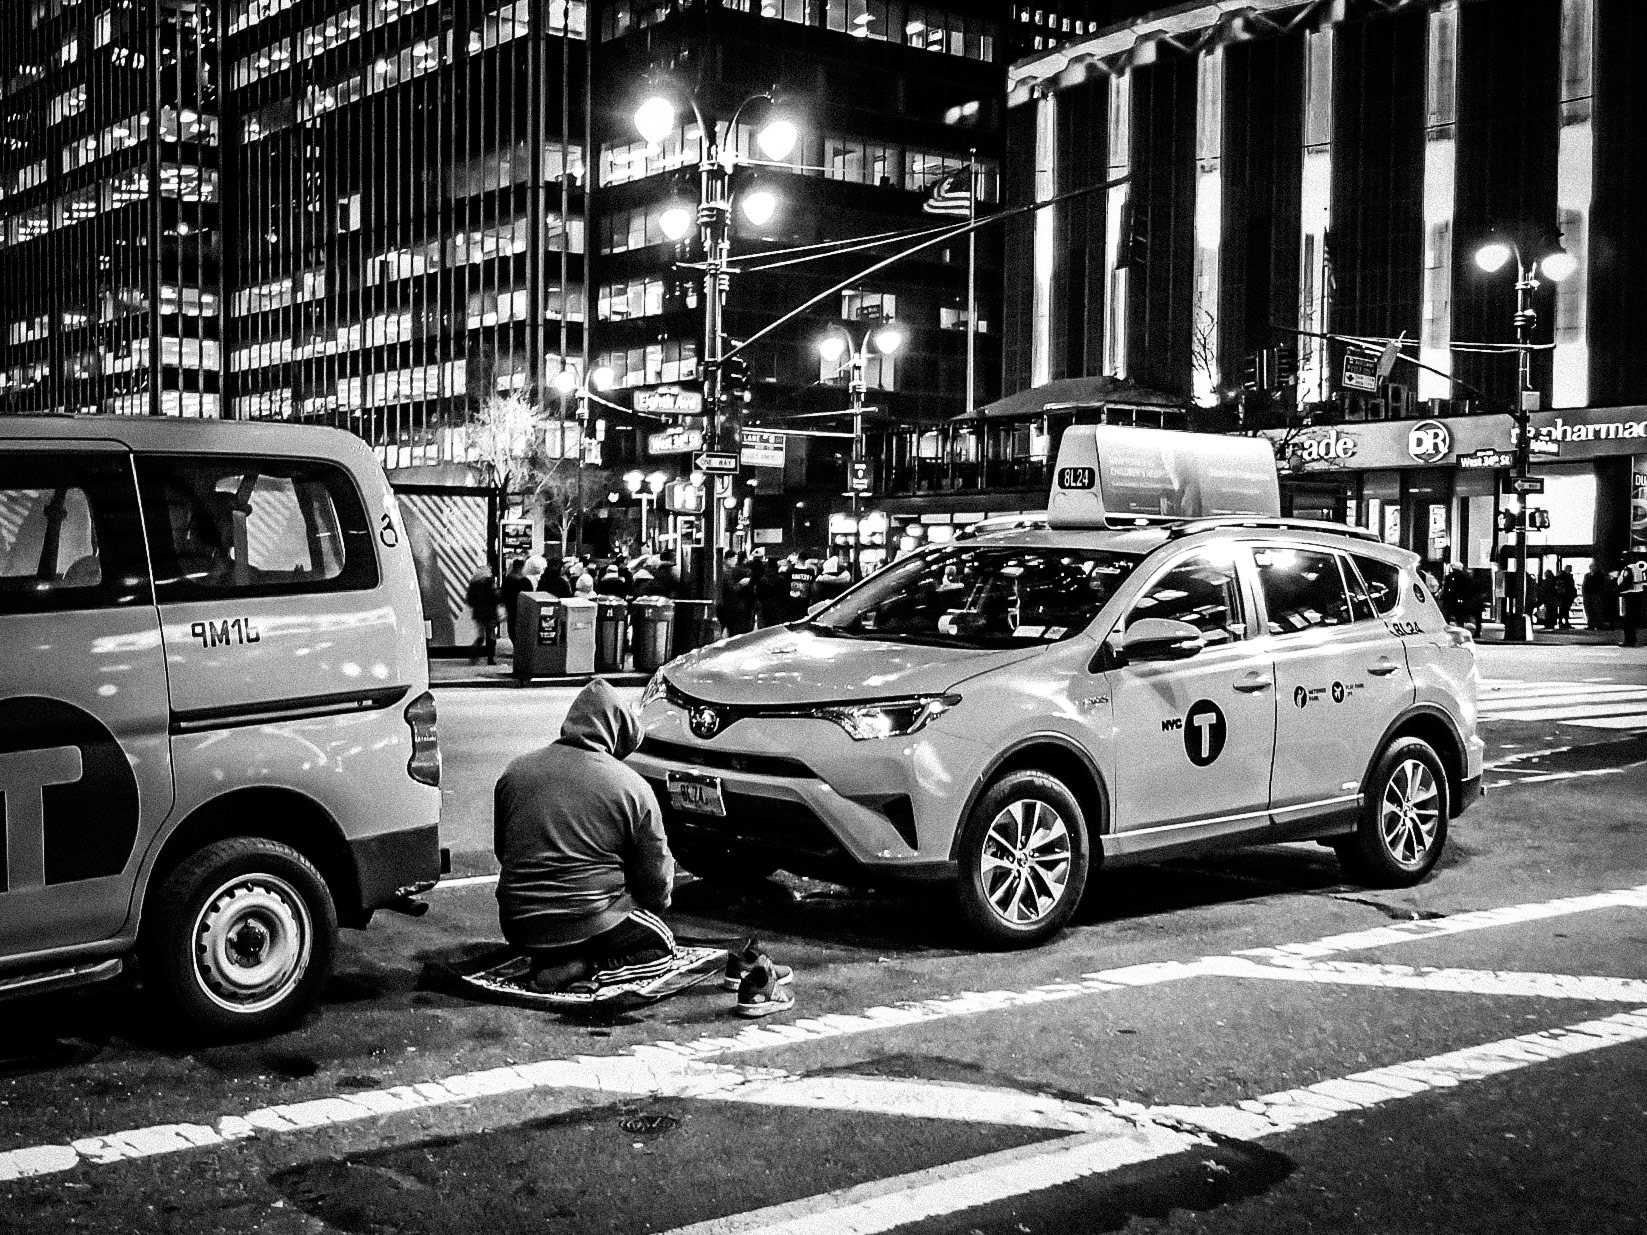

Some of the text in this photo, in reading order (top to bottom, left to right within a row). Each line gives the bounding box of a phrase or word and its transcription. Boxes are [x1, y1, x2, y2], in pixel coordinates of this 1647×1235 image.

[638, 393, 698, 411] Eighth Ave
[1408, 428, 1449, 455] DR
[1461, 457, 1482, 467] West
[1064, 468, 1089, 487] 8L24
[1161, 712, 1217, 758] NYC T
[0, 745, 83, 892] T
